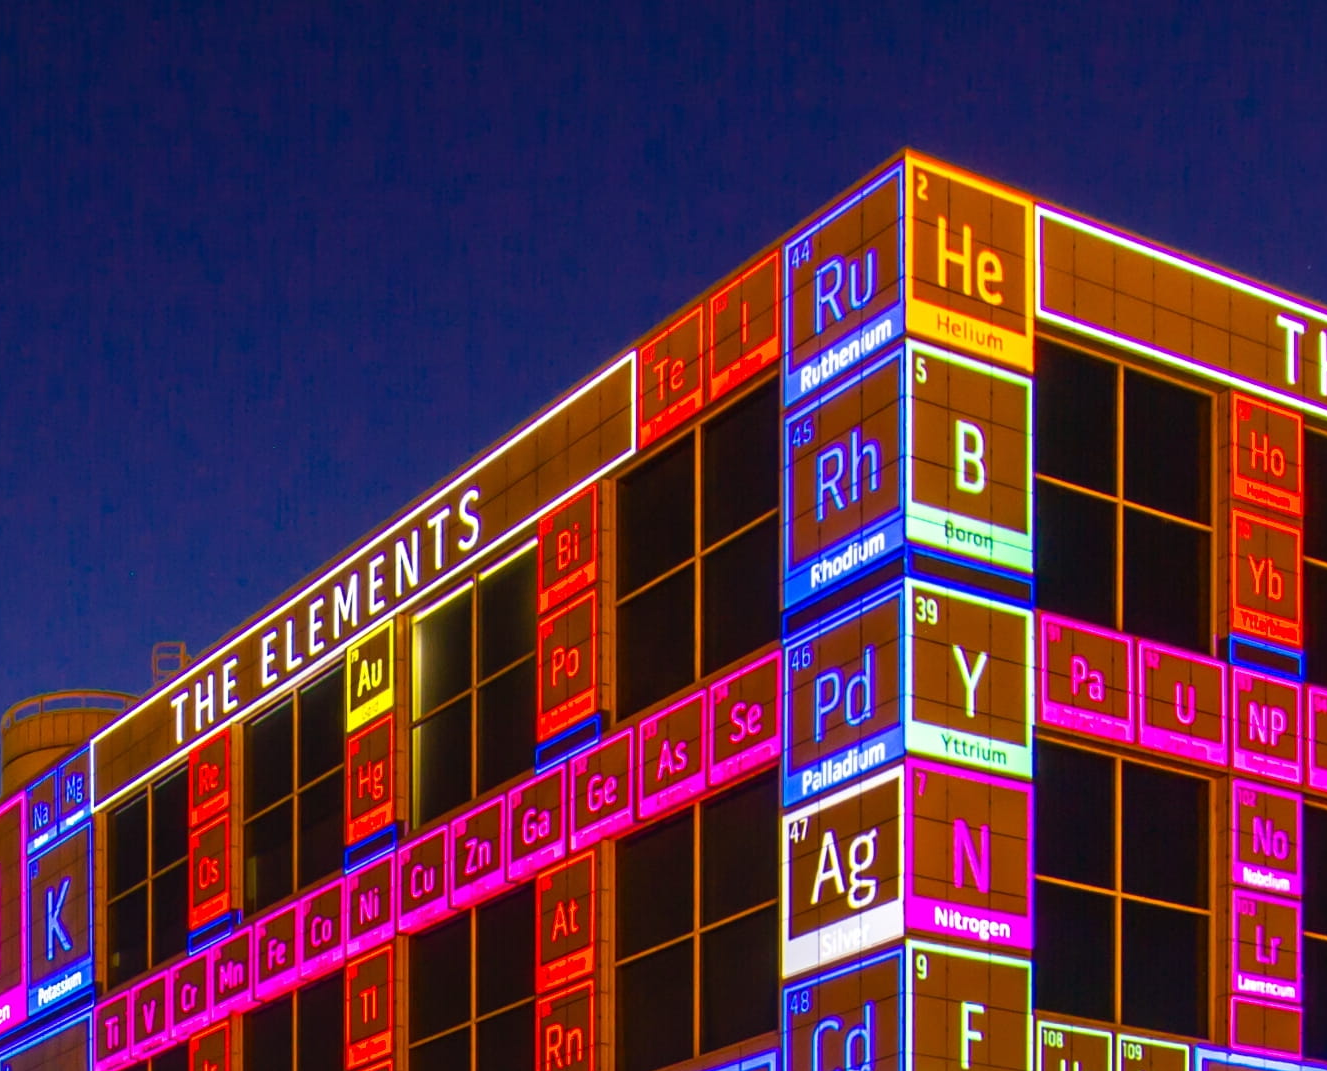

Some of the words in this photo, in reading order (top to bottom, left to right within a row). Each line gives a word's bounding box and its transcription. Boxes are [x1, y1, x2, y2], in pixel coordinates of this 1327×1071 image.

[938, 215, 1003, 306] He
[815, 251, 874, 334] Ru
[936, 312, 1003, 352] Helium
[801, 319, 892, 393] Ruthenium
[915, 358, 927, 384] 5
[817, 427, 880, 521] Rh
[955, 420, 986, 494] B
[944, 520, 994, 549] Boron
[811, 532, 885, 588] Rhodium
[171, 657, 237, 744] THE
[261, 489, 480, 688] ELEMENTS
[915, 597, 938, 625] 39
[357, 659, 382, 697] Au
[791, 647, 811, 671] 46
[1072, 656, 1105, 702] Pa
[816, 647, 872, 743] Pd
[953, 645, 987, 718] Y
[729, 702, 762, 744] Se
[1175, 683, 1195, 726] U
[656, 740, 688, 781] As
[802, 742, 885, 795] Palladium
[941, 734, 1007, 765] Yttrium
[587, 774, 618, 812] Ge
[522, 809, 551, 845] Ga
[789, 819, 808, 843] 47
[1252, 817, 1289, 859] No
[811, 828, 878, 909] Ag
[953, 819, 990, 894] N
[47, 877, 71, 960] K
[311, 916, 332, 947] Co
[934, 907, 1010, 941] Nitrogen
[267, 939, 287, 971] Fe
[821, 922, 871, 957] Silver
[1255, 925, 1281, 965] Lr
[916, 954, 928, 979] 9
[38, 970, 82, 1007] Potassium
[181, 981, 197, 1015] Cr
[790, 992, 810, 1014] 48
[105, 1019, 119, 1050] Ti
[142, 1001, 157, 1034] V
[960, 1002, 985, 1069] F
[1043, 1029, 1063, 1049] 108
